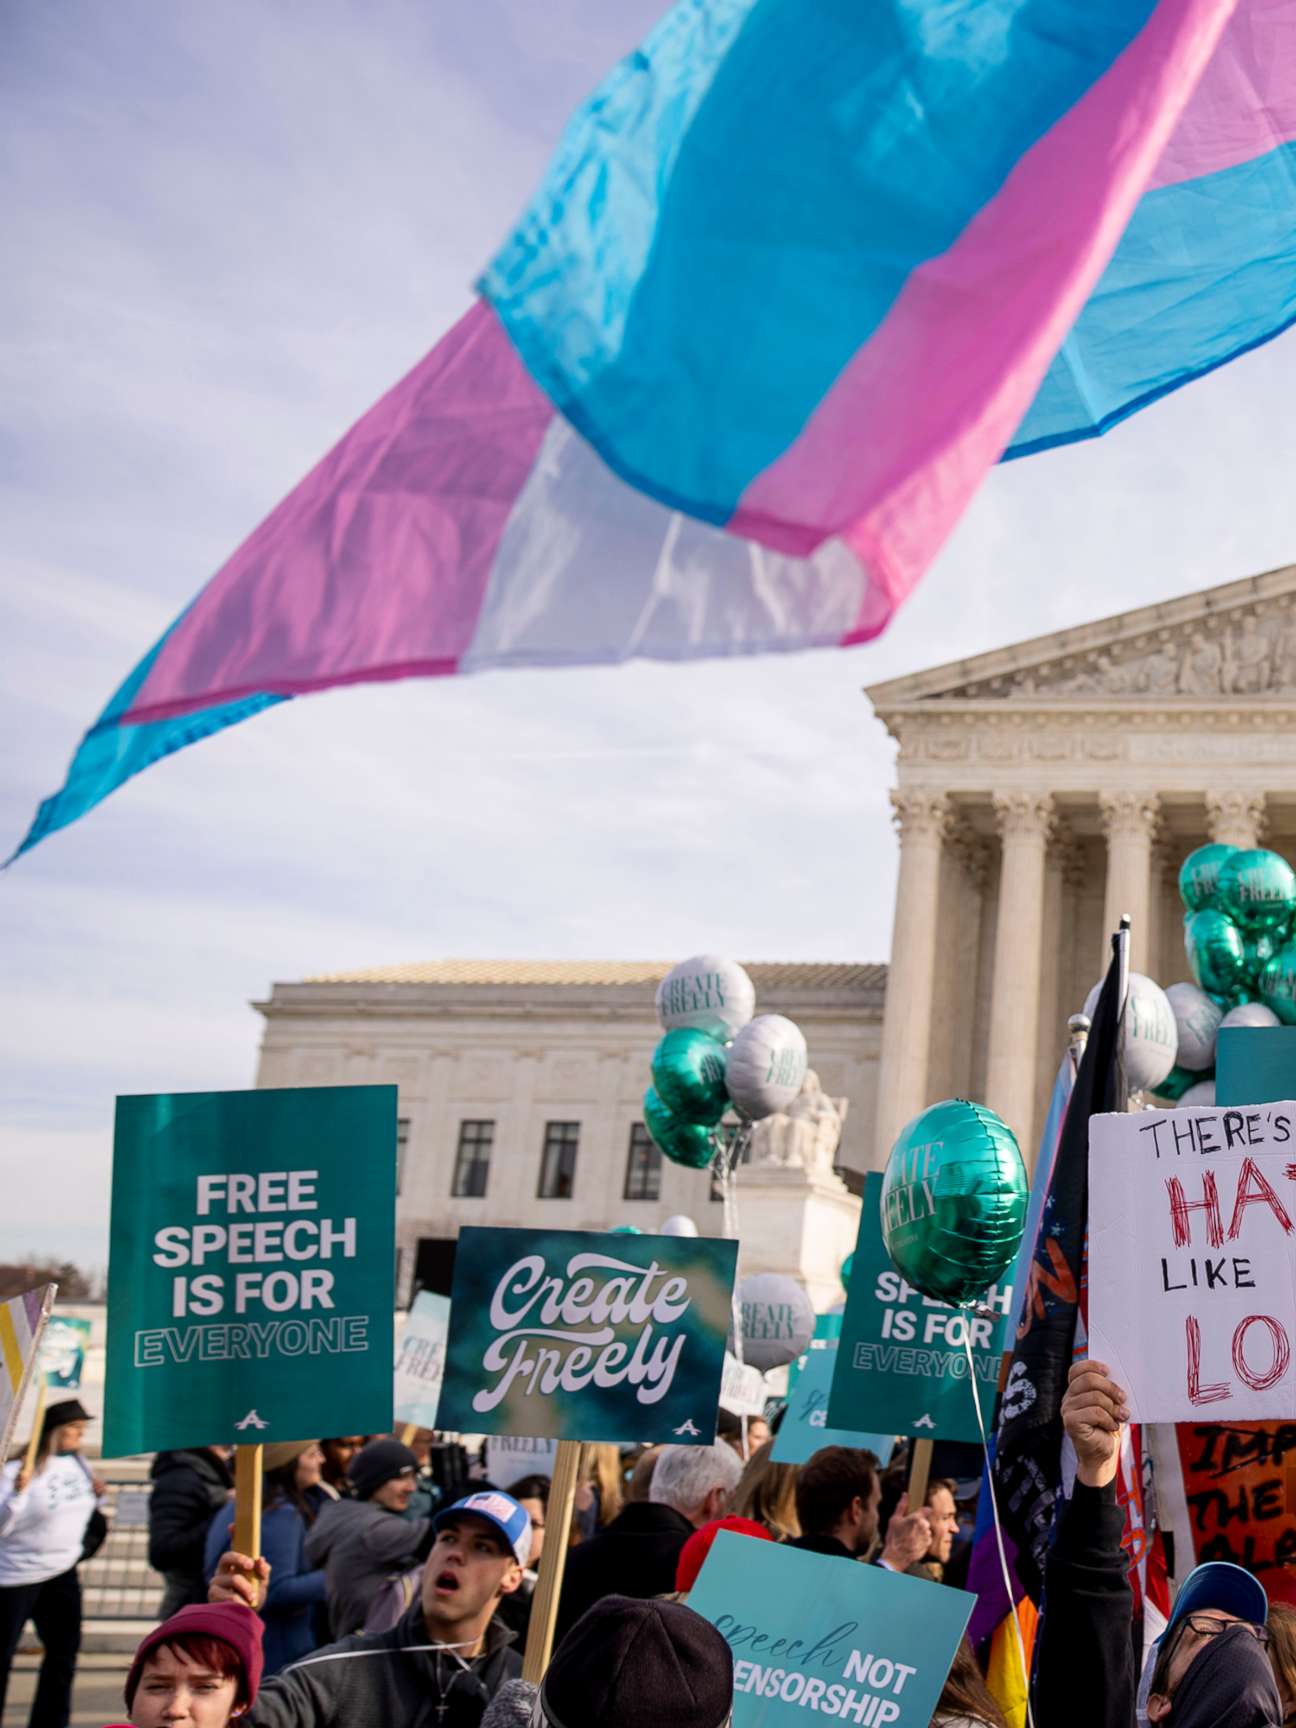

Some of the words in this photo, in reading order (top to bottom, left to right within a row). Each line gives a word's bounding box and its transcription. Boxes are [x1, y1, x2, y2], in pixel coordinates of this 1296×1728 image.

[1140, 1111, 1291, 1158] THERE'S
[195, 1169, 319, 1216] FREE
[152, 1216, 357, 1269] SPEECH
[172, 1273, 224, 1318] IS
[235, 1268, 336, 1314] FOR
[489, 1252, 692, 1332] Create
[1161, 1257, 1257, 1292] LIKE
[134, 1314, 370, 1369] EVERYONE
[880, 1307, 918, 1342] IS
[922, 1313, 993, 1349] FOR
[471, 1322, 688, 1414] Freely
[1186, 1478, 1284, 1532] THE
[732, 1659, 901, 1728] ENSORSHIP
[842, 1649, 917, 1695] NOT
